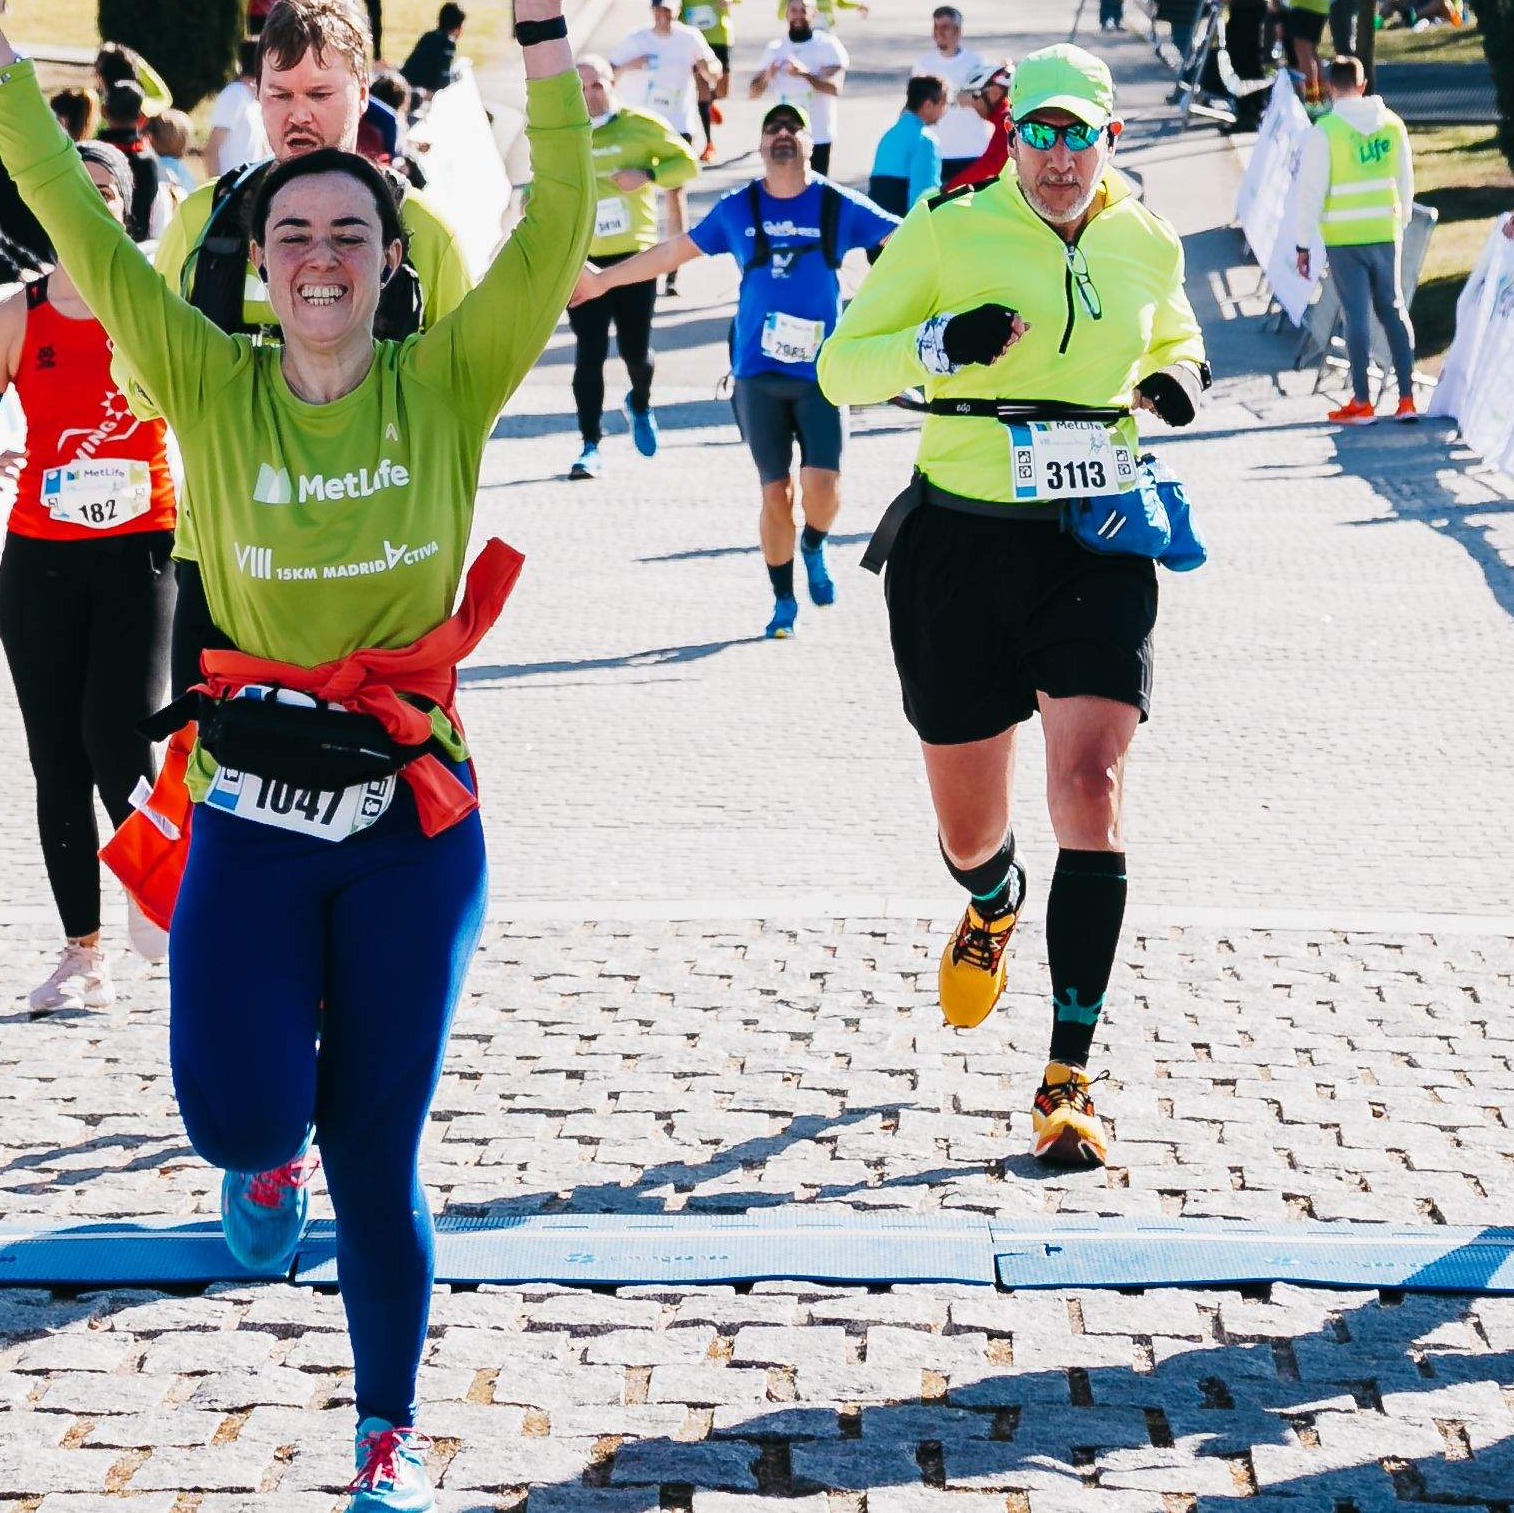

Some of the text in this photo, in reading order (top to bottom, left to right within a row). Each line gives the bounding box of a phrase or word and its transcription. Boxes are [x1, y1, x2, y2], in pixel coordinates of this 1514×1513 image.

[1056, 421, 1102, 431] MetLife
[84, 468, 126, 478] MetLife
[299, 459, 410, 504] MetLife
[1047, 461, 1106, 490] 3113
[79, 499, 118, 524] 182
[234, 542, 273, 580] VIII
[276, 568, 318, 581] 15KM
[256, 777, 345, 825] 1047
